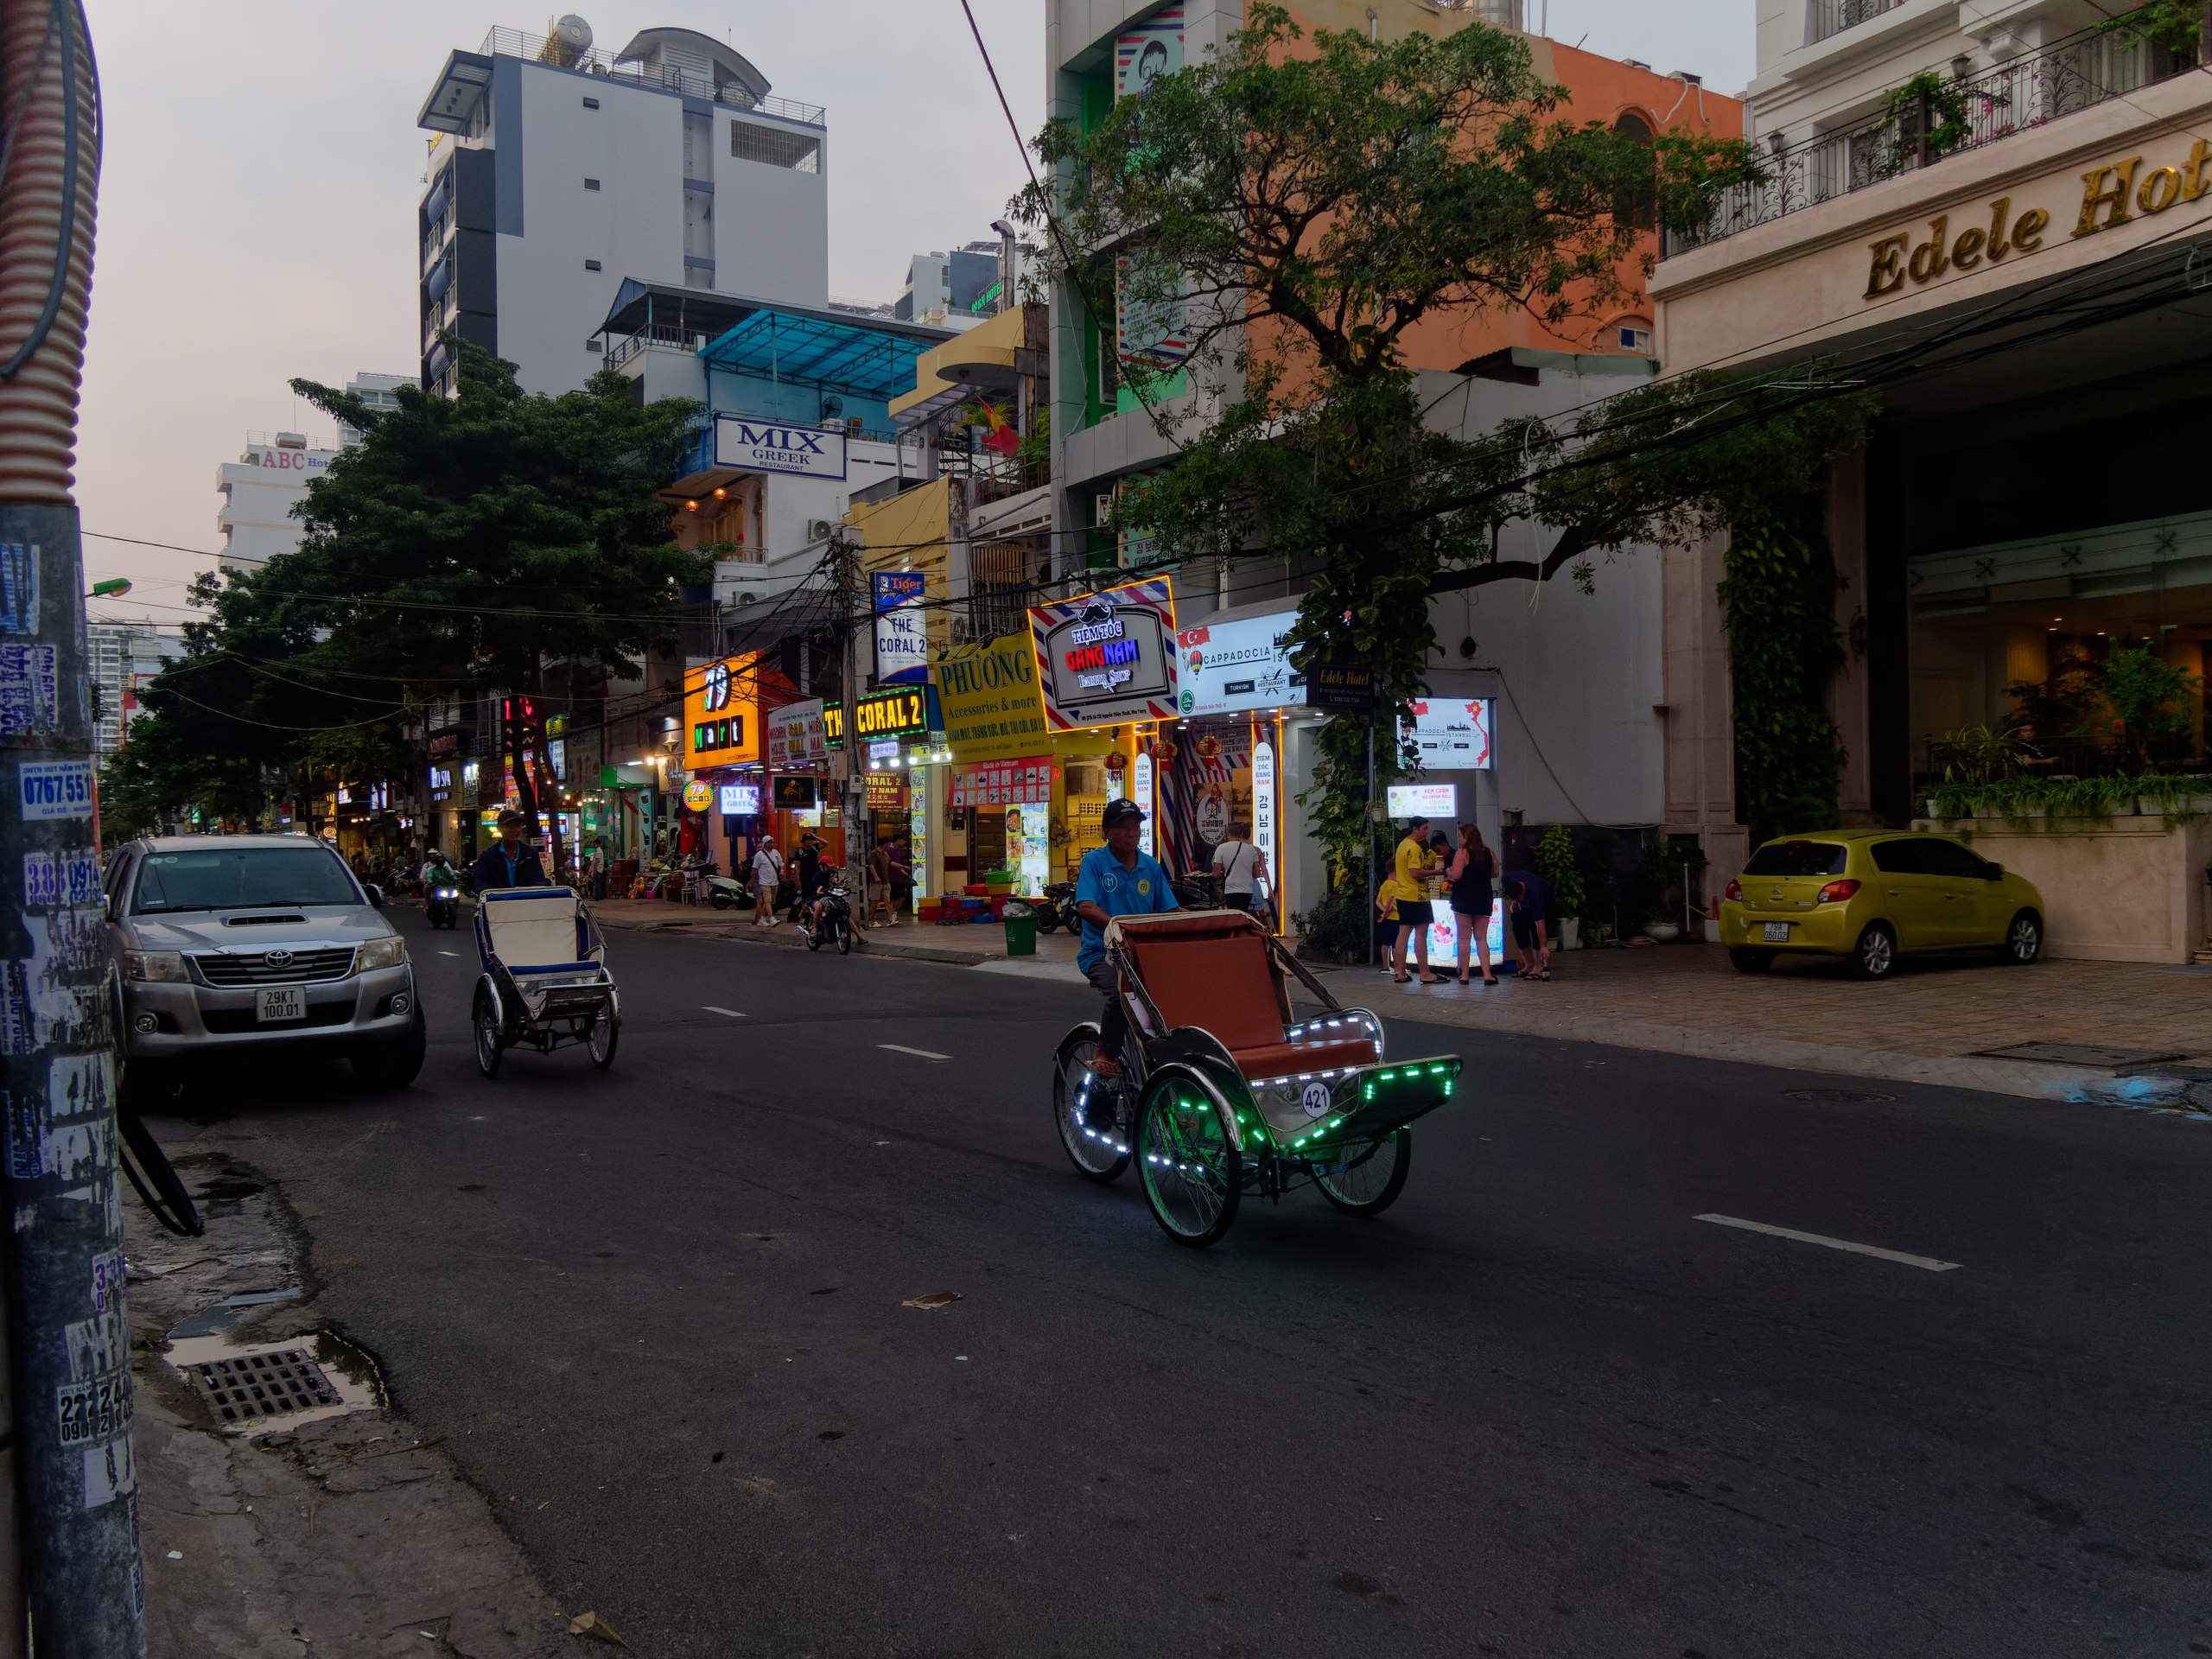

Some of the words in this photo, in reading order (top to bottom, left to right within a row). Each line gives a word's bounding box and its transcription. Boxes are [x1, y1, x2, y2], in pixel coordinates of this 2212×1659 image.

[1863, 196, 2049, 299] Edele
[737, 423, 825, 454] MIX
[263, 450, 304, 470] ABC
[308, 458, 331, 467] Hot
[752, 448, 810, 465] GREEK
[760, 461, 804, 472] RESTAURANT
[890, 576, 922, 593] Tiger
[891, 619, 912, 632] THE
[880, 639, 916, 652] CORAL
[919, 639, 925, 652] 2
[1065, 639, 1140, 671] GANGNAM
[1204, 646, 1270, 664] CAPPADOCIA
[940, 649, 1032, 696] PHƯƠNG
[1319, 669, 1344, 684] Edele
[1346, 670, 1370, 686] Hotel
[1230, 683, 1250, 691] TURKISH
[1257, 679, 1286, 689] RESTAURANT
[824, 709, 843, 737] TH
[857, 698, 906, 733] CORAL
[910, 696, 919, 725] 2
[948, 700, 999, 720] Accessories
[1001, 697, 1009, 710] &
[1012, 697, 1036, 709] more
[1001, 759, 1019, 767] Vietnam
[865, 777, 893, 785] ORAL
[266, 990, 296, 1004] 29KT
[264, 1003, 299, 1018] 100.01
[1306, 1089, 1326, 1109] 421
